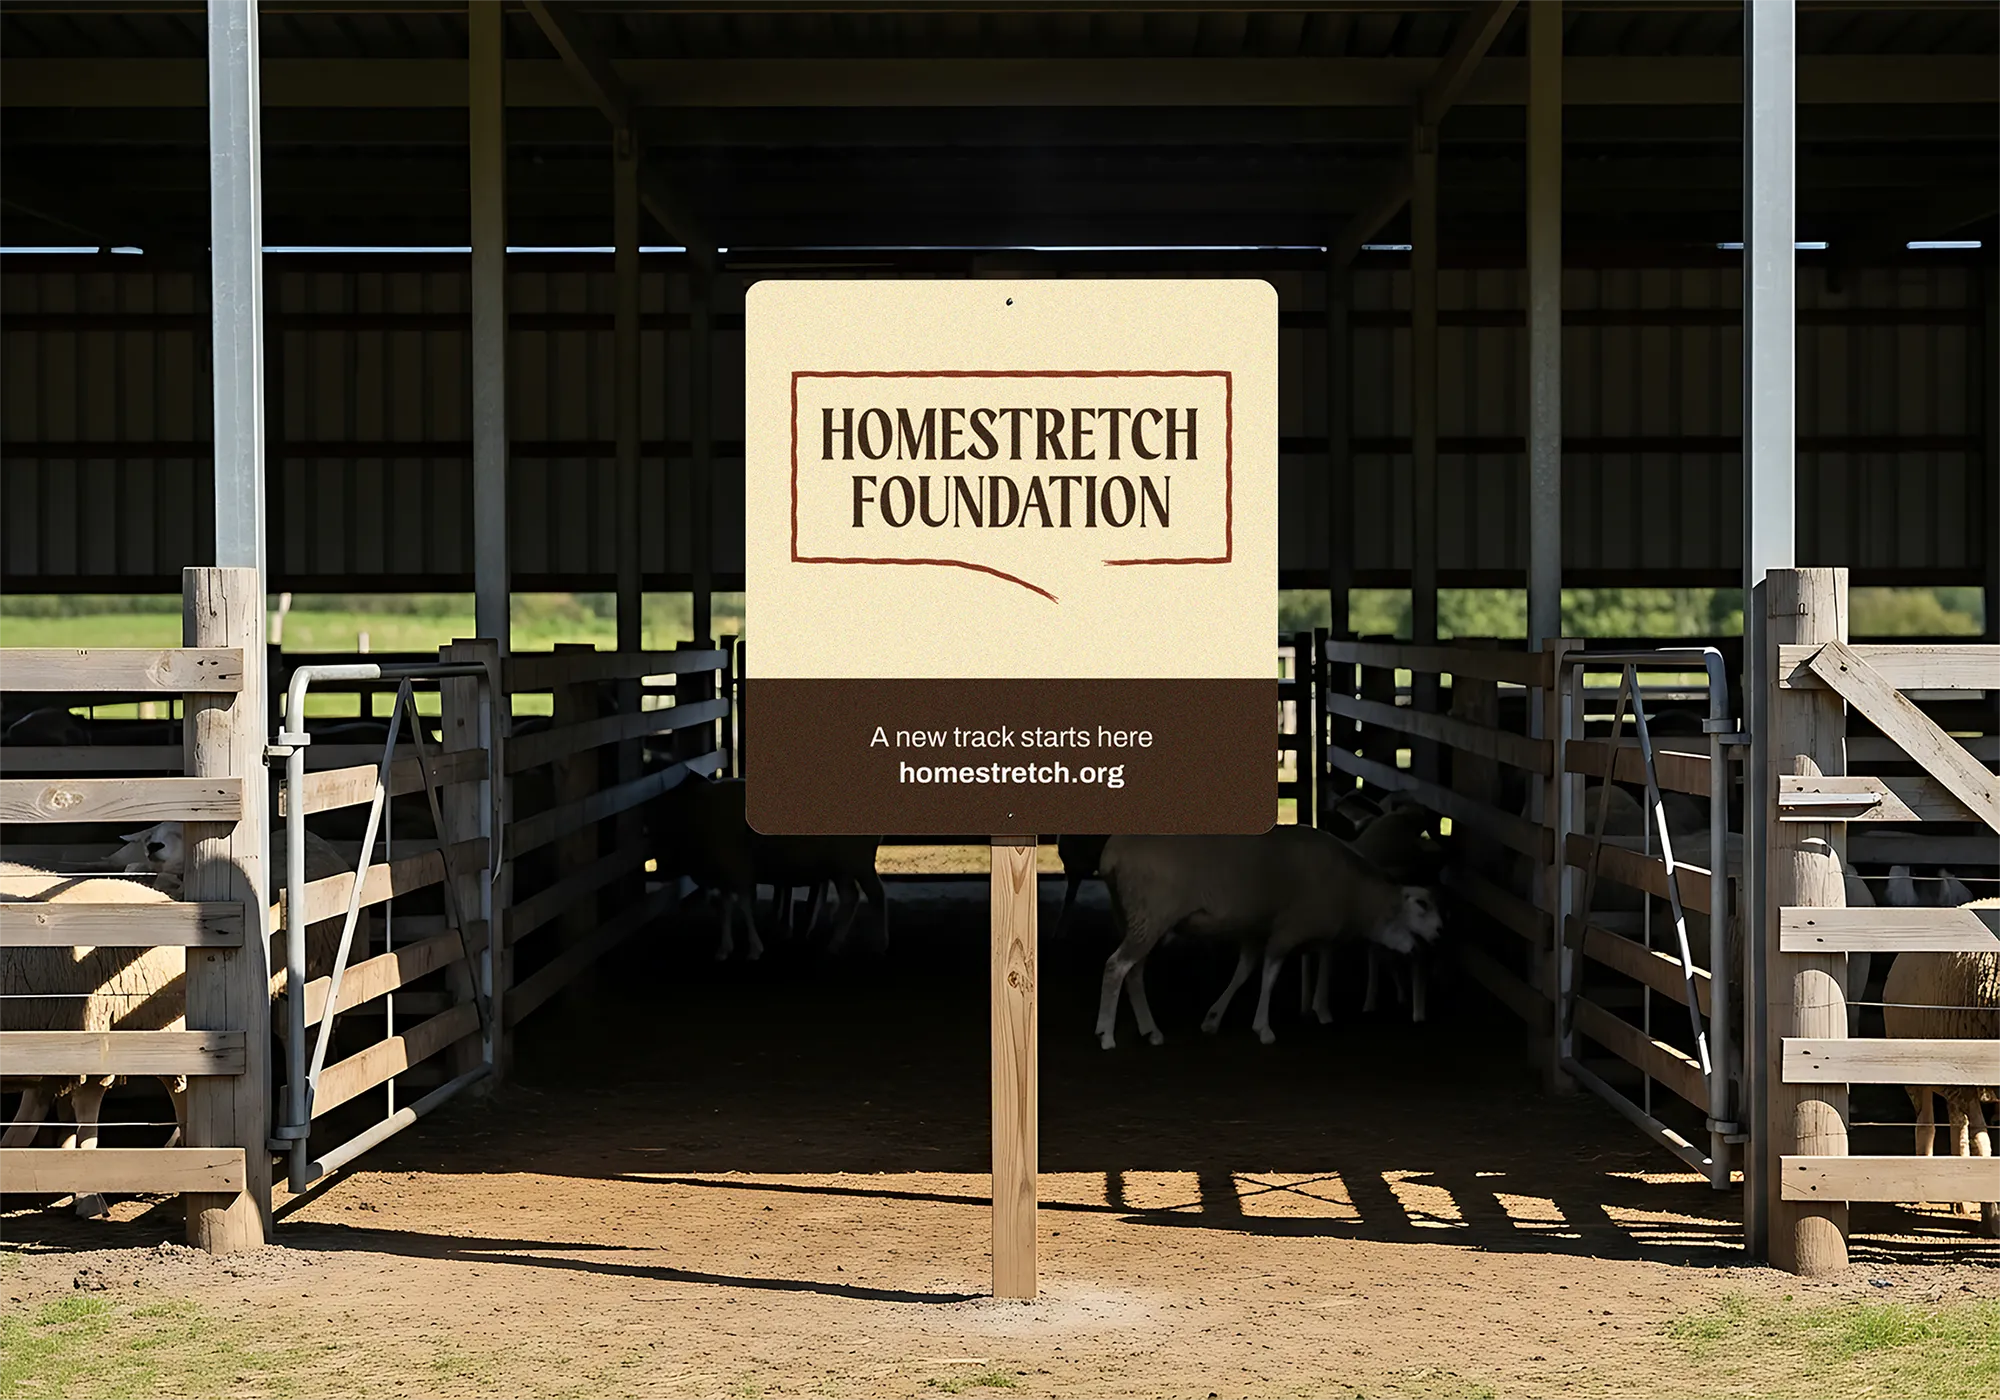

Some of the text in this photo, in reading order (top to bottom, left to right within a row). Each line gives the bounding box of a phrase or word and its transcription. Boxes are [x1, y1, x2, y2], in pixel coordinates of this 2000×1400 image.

[821, 407, 1199, 461] HOMESTRETCH
[851, 475, 1172, 529] FOUNDATION
[869, 725, 1154, 748] A new track starts here
[899, 761, 1126, 789] homestretch.org
